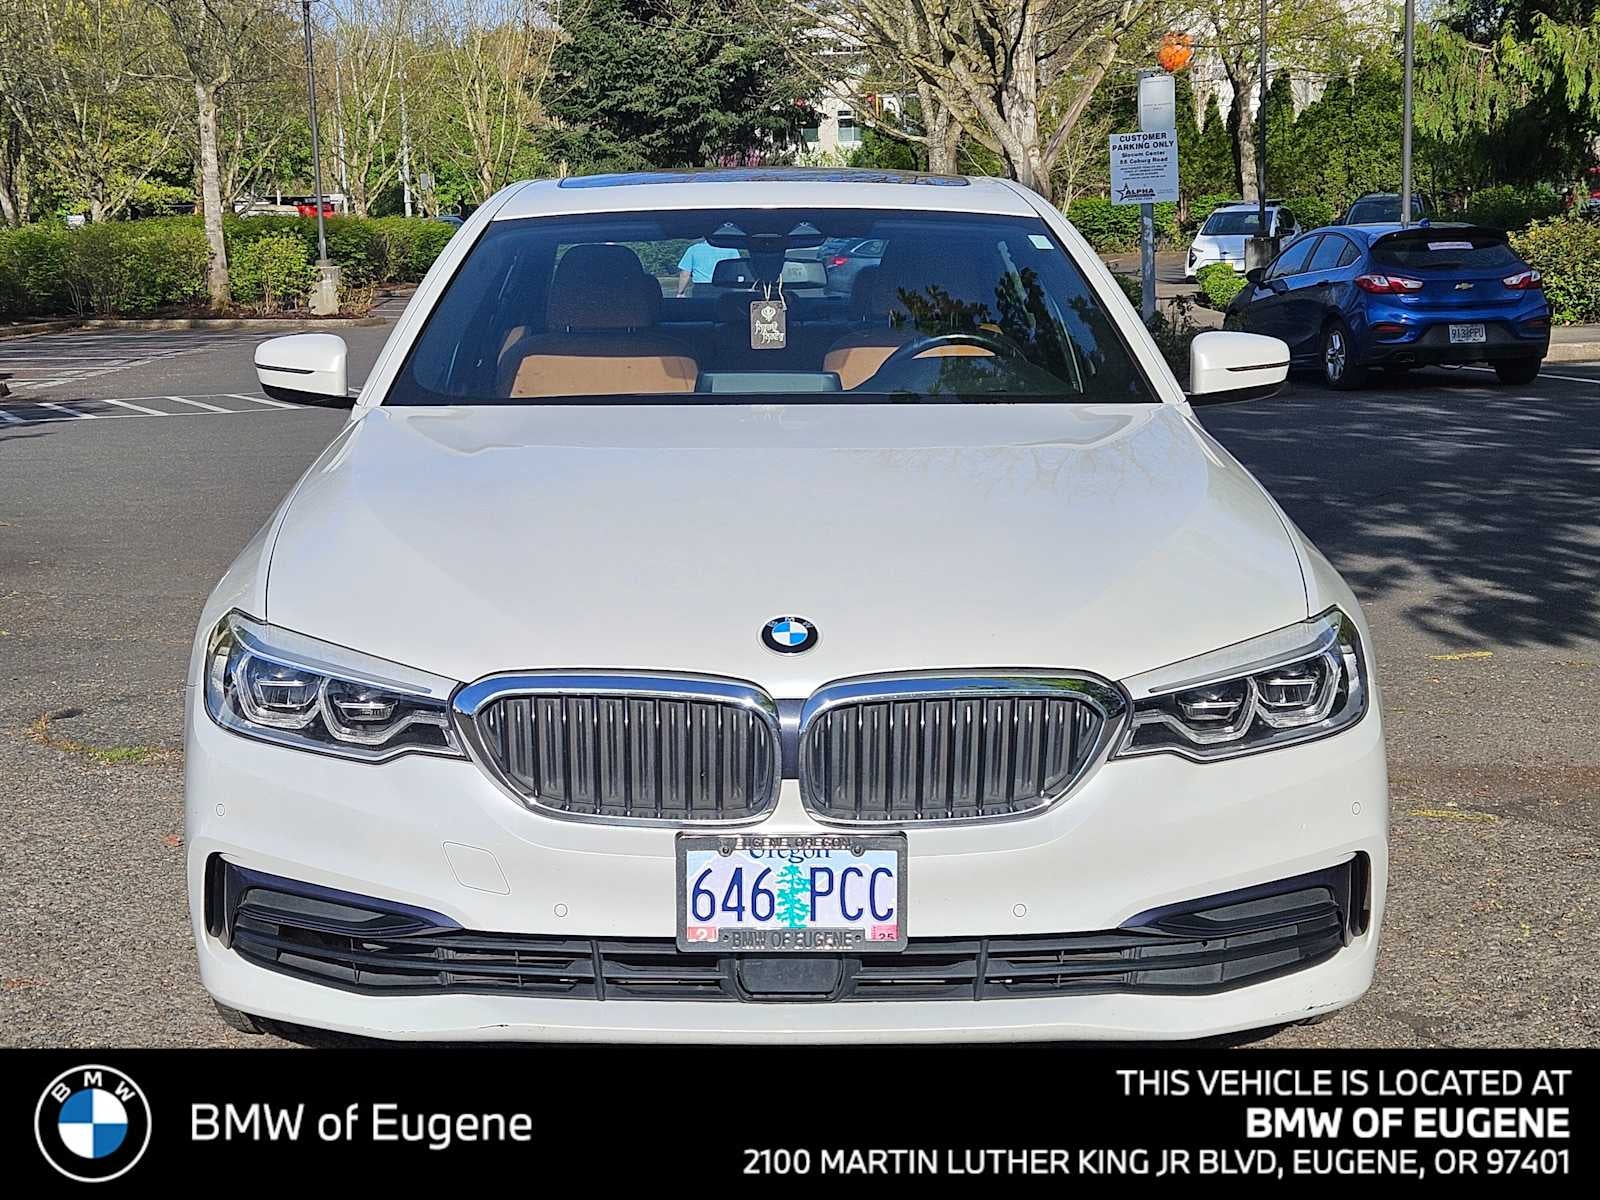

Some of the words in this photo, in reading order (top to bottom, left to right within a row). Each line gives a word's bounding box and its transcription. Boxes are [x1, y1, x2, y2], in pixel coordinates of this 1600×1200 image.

[1119, 132, 1167, 143] CUSTOMER
[1112, 142, 1150, 151] PARKING
[1152, 140, 1175, 149] ONLY
[1129, 157, 1151, 165] Coburg
[691, 867, 775, 922] 646
[810, 867, 894, 922] PCC
[732, 931, 768, 949] BMW
[771, 931, 793, 949] OF
[795, 931, 853, 949] EUGENE
